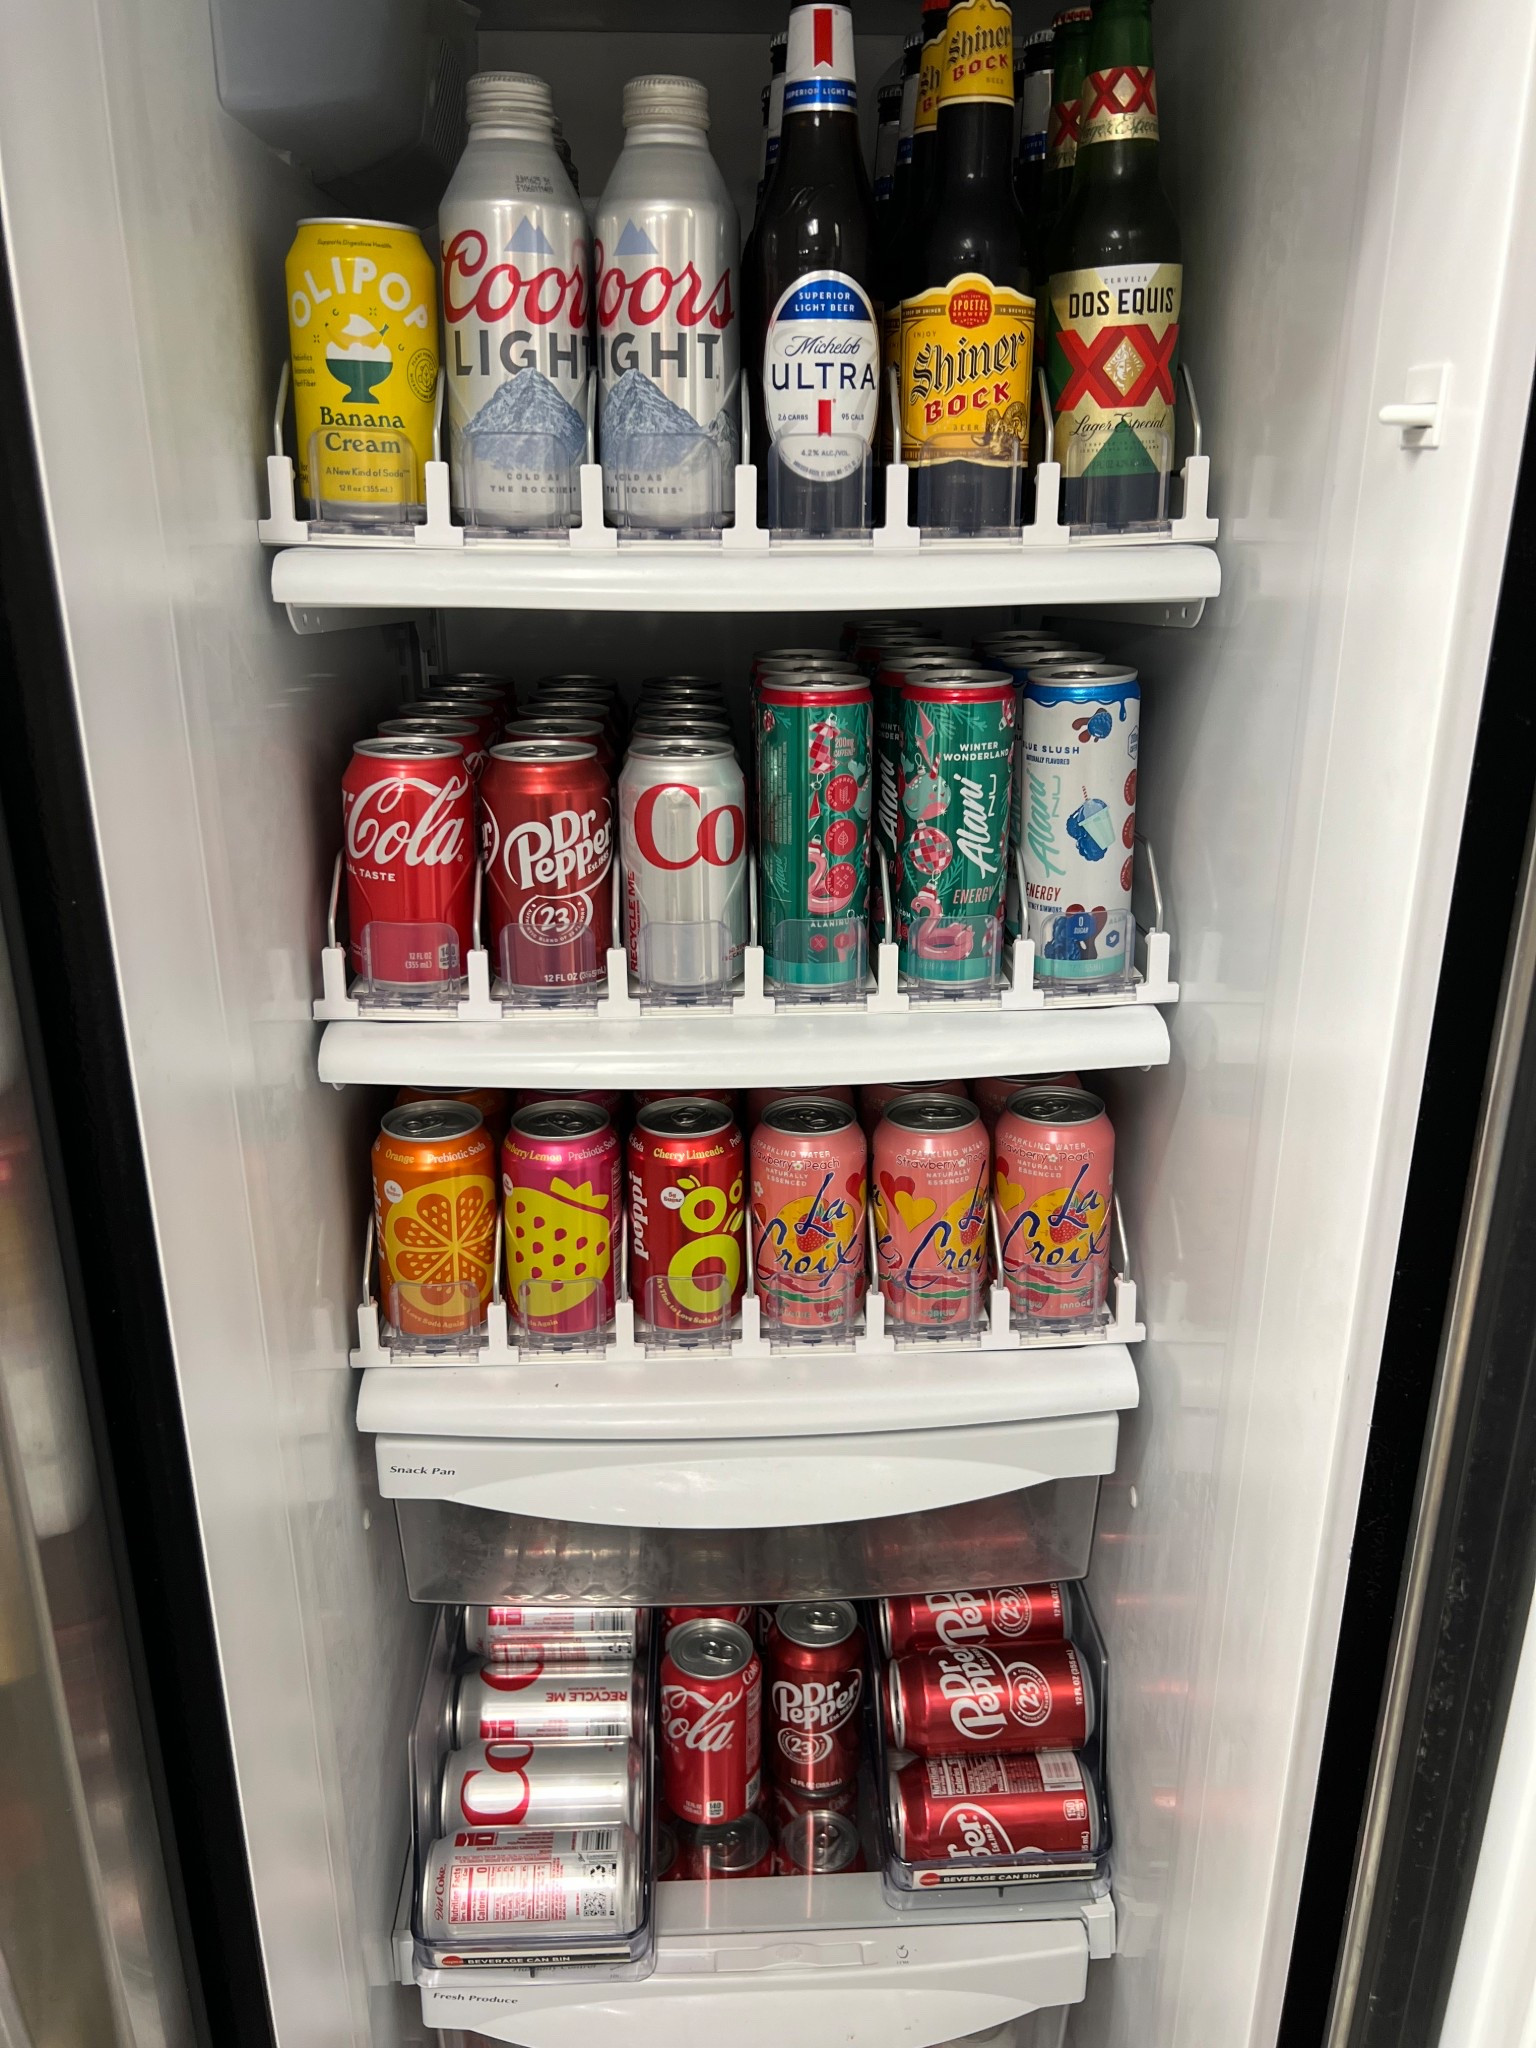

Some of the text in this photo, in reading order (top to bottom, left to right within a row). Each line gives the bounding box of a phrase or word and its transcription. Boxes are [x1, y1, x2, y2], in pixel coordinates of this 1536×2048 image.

[949, 25, 1011, 65] Shiner
[953, 54, 1008, 82] BOCK
[442, 229, 588, 329] Coor
[1104, 276, 1148, 284] CERVEZA
[292, 256, 429, 329] OLIPOP
[799, 292, 851, 300] SUPERIOR
[795, 304, 855, 312] LIGHT BEER
[953, 300, 989, 311] SPOETZL
[1069, 287, 1174, 319] DOS EQUIS
[600, 332, 721, 379] IGHT
[785, 336, 862, 357] Michelob
[910, 330, 1026, 404] Shiner
[772, 363, 876, 390] ULTRA
[924, 381, 1010, 425] BOCK
[320, 406, 406, 429] Banana
[1069, 412, 1167, 441] Lager Especial
[325, 432, 401, 453] Cream
[325, 467, 332, 475] A
[333, 468, 350, 476] New
[352, 468, 371, 477] Kind
[507, 473, 540, 481] COLD
[647, 474, 662, 482] AS
[490, 485, 513, 493] THE
[943, 749, 1009, 761] WONDERLAND
[960, 742, 999, 752] WINTER
[1042, 746, 1080, 754] SLUSH
[1045, 757, 1070, 765] FLAVORED
[348, 775, 469, 867] Cola
[634, 782, 746, 871] Co
[953, 773, 998, 879] Alani
[549, 809, 597, 854] Dr
[504, 818, 612, 890] Pepper
[359, 868, 396, 881] TASTE
[627, 869, 636, 894] ME
[953, 885, 994, 904] ENERGY
[540, 906, 571, 933] 23
[1079, 917, 1084, 926] 0
[628, 896, 639, 972] RECYCLE
[405, 961, 419, 969] (355
[409, 952, 432, 960] 12 FL OZ
[544, 972, 578, 982] 12 FL OZ
[757, 1140, 796, 1158] SPARKLING
[799, 1150, 831, 1159] WATER
[1004, 1132, 1086, 1151] SPARKLING WATER
[386, 1141, 486, 1164] Orange Prebiotic Soda
[530, 1145, 604, 1163] Lemon Prebiotic
[653, 1145, 725, 1163] Cherry Limeade
[905, 1148, 959, 1158] SPARKLING
[1058, 1149, 1095, 1162] Peach
[803, 1156, 840, 1171] Peach
[896, 1154, 958, 1171] Strawberry
[1017, 1158, 1064, 1171] NATURALLY
[766, 1167, 808, 1179] NATURALLY
[767, 1174, 807, 1187] ESSENCED
[926, 1167, 971, 1178] NATURALLY
[928, 1176, 969, 1186] ESSENCED
[1018, 1166, 1062, 1178] ESSENCED
[663, 1195, 683, 1204] Sugar
[794, 1171, 849, 1237] La
[1047, 1162, 1101, 1229] La
[629, 1170, 650, 1261] poppi
[755, 1217, 858, 1288] Croix
[1003, 1210, 1107, 1279] Croix
[442, 1319, 465, 1328] Again
[676, 1309, 693, 1322] Love
[693, 1316, 712, 1324] Soda
[389, 1465, 456, 1476] Snack Pan
[1000, 1595, 1021, 1620] 23
[1052, 1599, 1061, 1609] FL
[1053, 1609, 1061, 1617] 12
[936, 1592, 990, 1646] Pep
[1069, 1660, 1080, 1675] (355
[938, 1660, 970, 1700] Dr
[1072, 1675, 1081, 1687] OZ
[546, 1691, 628, 1702] RECYCLE ME
[801, 1681, 841, 1708] Dr
[947, 1646, 1008, 1739] Pepper
[1018, 1682, 1040, 1709] 23
[1073, 1688, 1082, 1697] FL
[1075, 1697, 1083, 1706] 12
[772, 1678, 859, 1730] Pepper
[791, 1737, 812, 1756] 23
[1065, 1802, 1075, 1817] 150
[451, 1867, 461, 1889] Facts
[943, 1875, 996, 1883] BEVERAGE
[434, 1866, 447, 1921] Diet Coke
[433, 1992, 519, 2004] Fresh Produce
